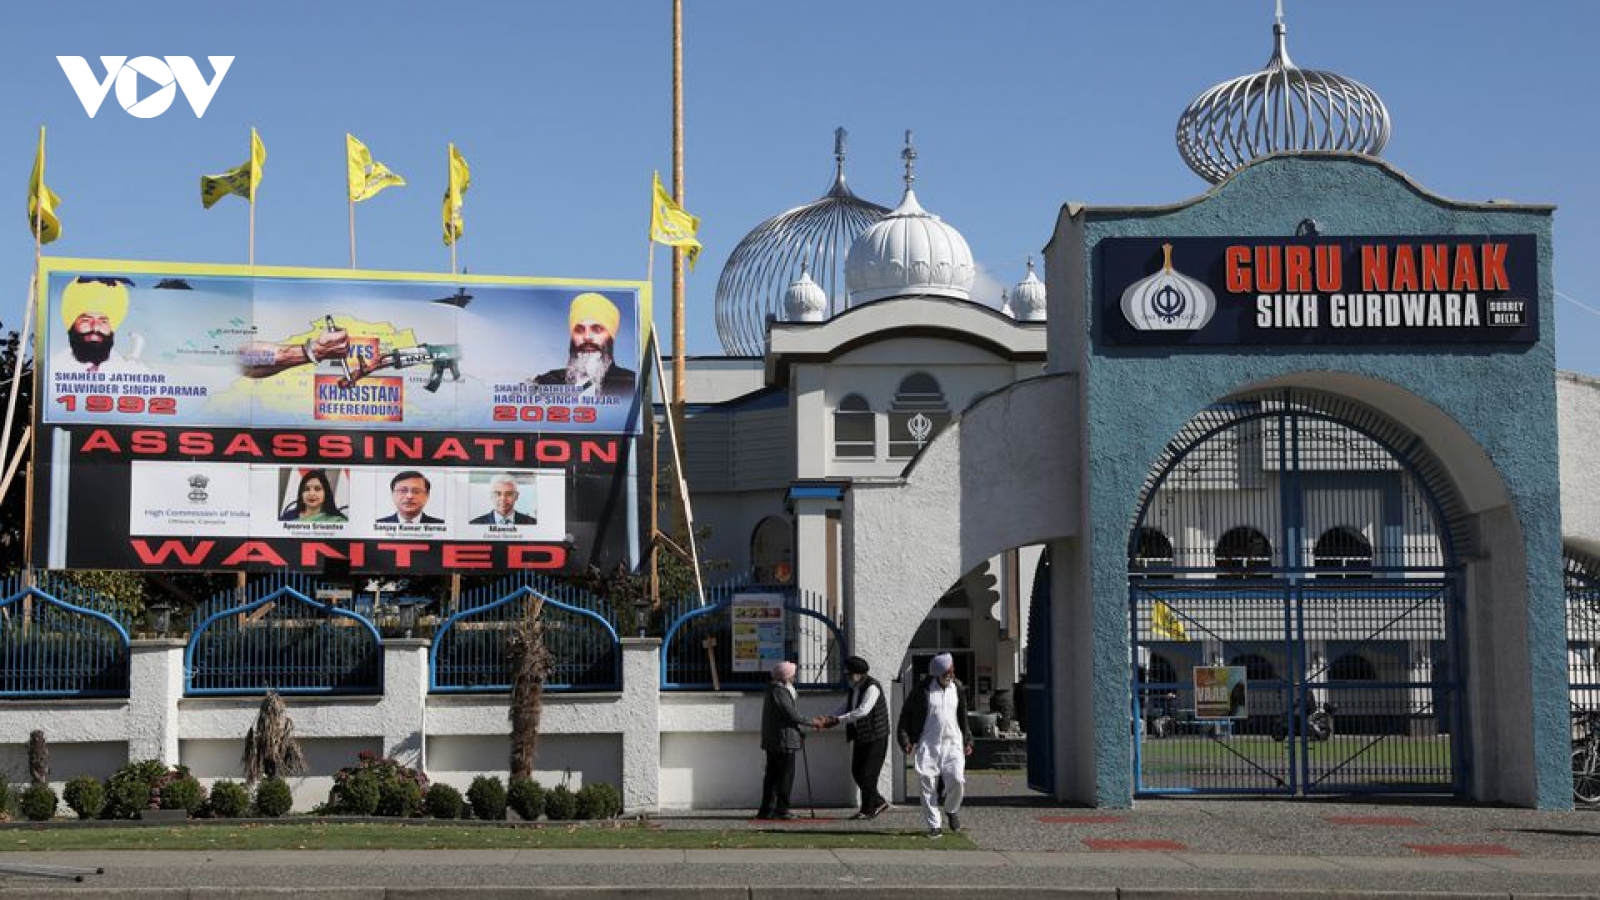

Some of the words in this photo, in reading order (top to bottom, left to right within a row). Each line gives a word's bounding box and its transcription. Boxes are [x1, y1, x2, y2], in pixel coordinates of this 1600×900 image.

[1225, 245, 1342, 293] GURU
[1361, 243, 1510, 292] NANAK
[1257, 294, 1319, 328] SIKH
[1330, 293, 1481, 328] GURDWARA
[1489, 301, 1524, 312] SURREY
[1494, 313, 1521, 324] DELTA
[347, 343, 374, 359] YES
[54, 372, 106, 382] SHAHEED
[109, 373, 166, 383] JATHEDAR
[55, 383, 119, 394] TALWINDER
[122, 385, 156, 395] SINGH
[160, 386, 208, 396] PARMAR
[319, 384, 399, 402] KHALISTAN
[56, 395, 177, 415] 1992
[494, 394, 541, 404] HARDEEP
[544, 395, 579, 404] SINGH
[582, 395, 620, 405] NIJJAR
[319, 403, 401, 416] REFERENDUM
[493, 405, 597, 423] 2023
[80, 429, 618, 463] ASSASSINATION
[144, 509, 164, 518] High
[219, 509, 228, 517] of
[130, 540, 566, 569] WANTED
